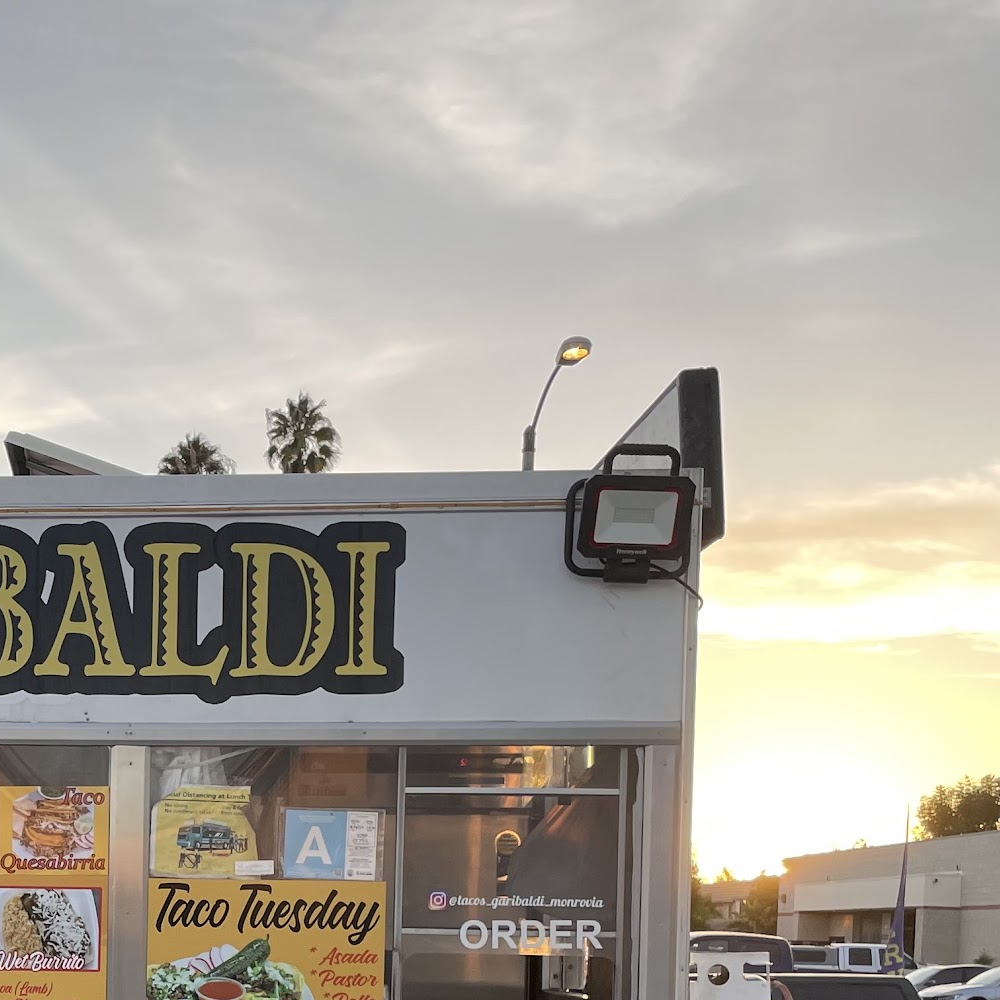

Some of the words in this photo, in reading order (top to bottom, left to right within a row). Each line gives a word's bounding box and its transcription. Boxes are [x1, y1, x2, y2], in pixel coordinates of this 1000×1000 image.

[60, 787, 105, 806] Taco
[295, 825, 332, 865] A
[0, 853, 106, 873] Quesabirria
[449, 894, 604, 910] @tacos_garibaldi_monrovia
[155, 882, 230, 933] Taco
[236, 883, 380, 945] Tuesday
[459, 919, 603, 950] ORDER
[31, 951, 86, 972] Burrito
[318, 947, 378, 966] Asada
[318, 969, 378, 987] Pastor
[14, 980, 53, 997] (Lamb)
